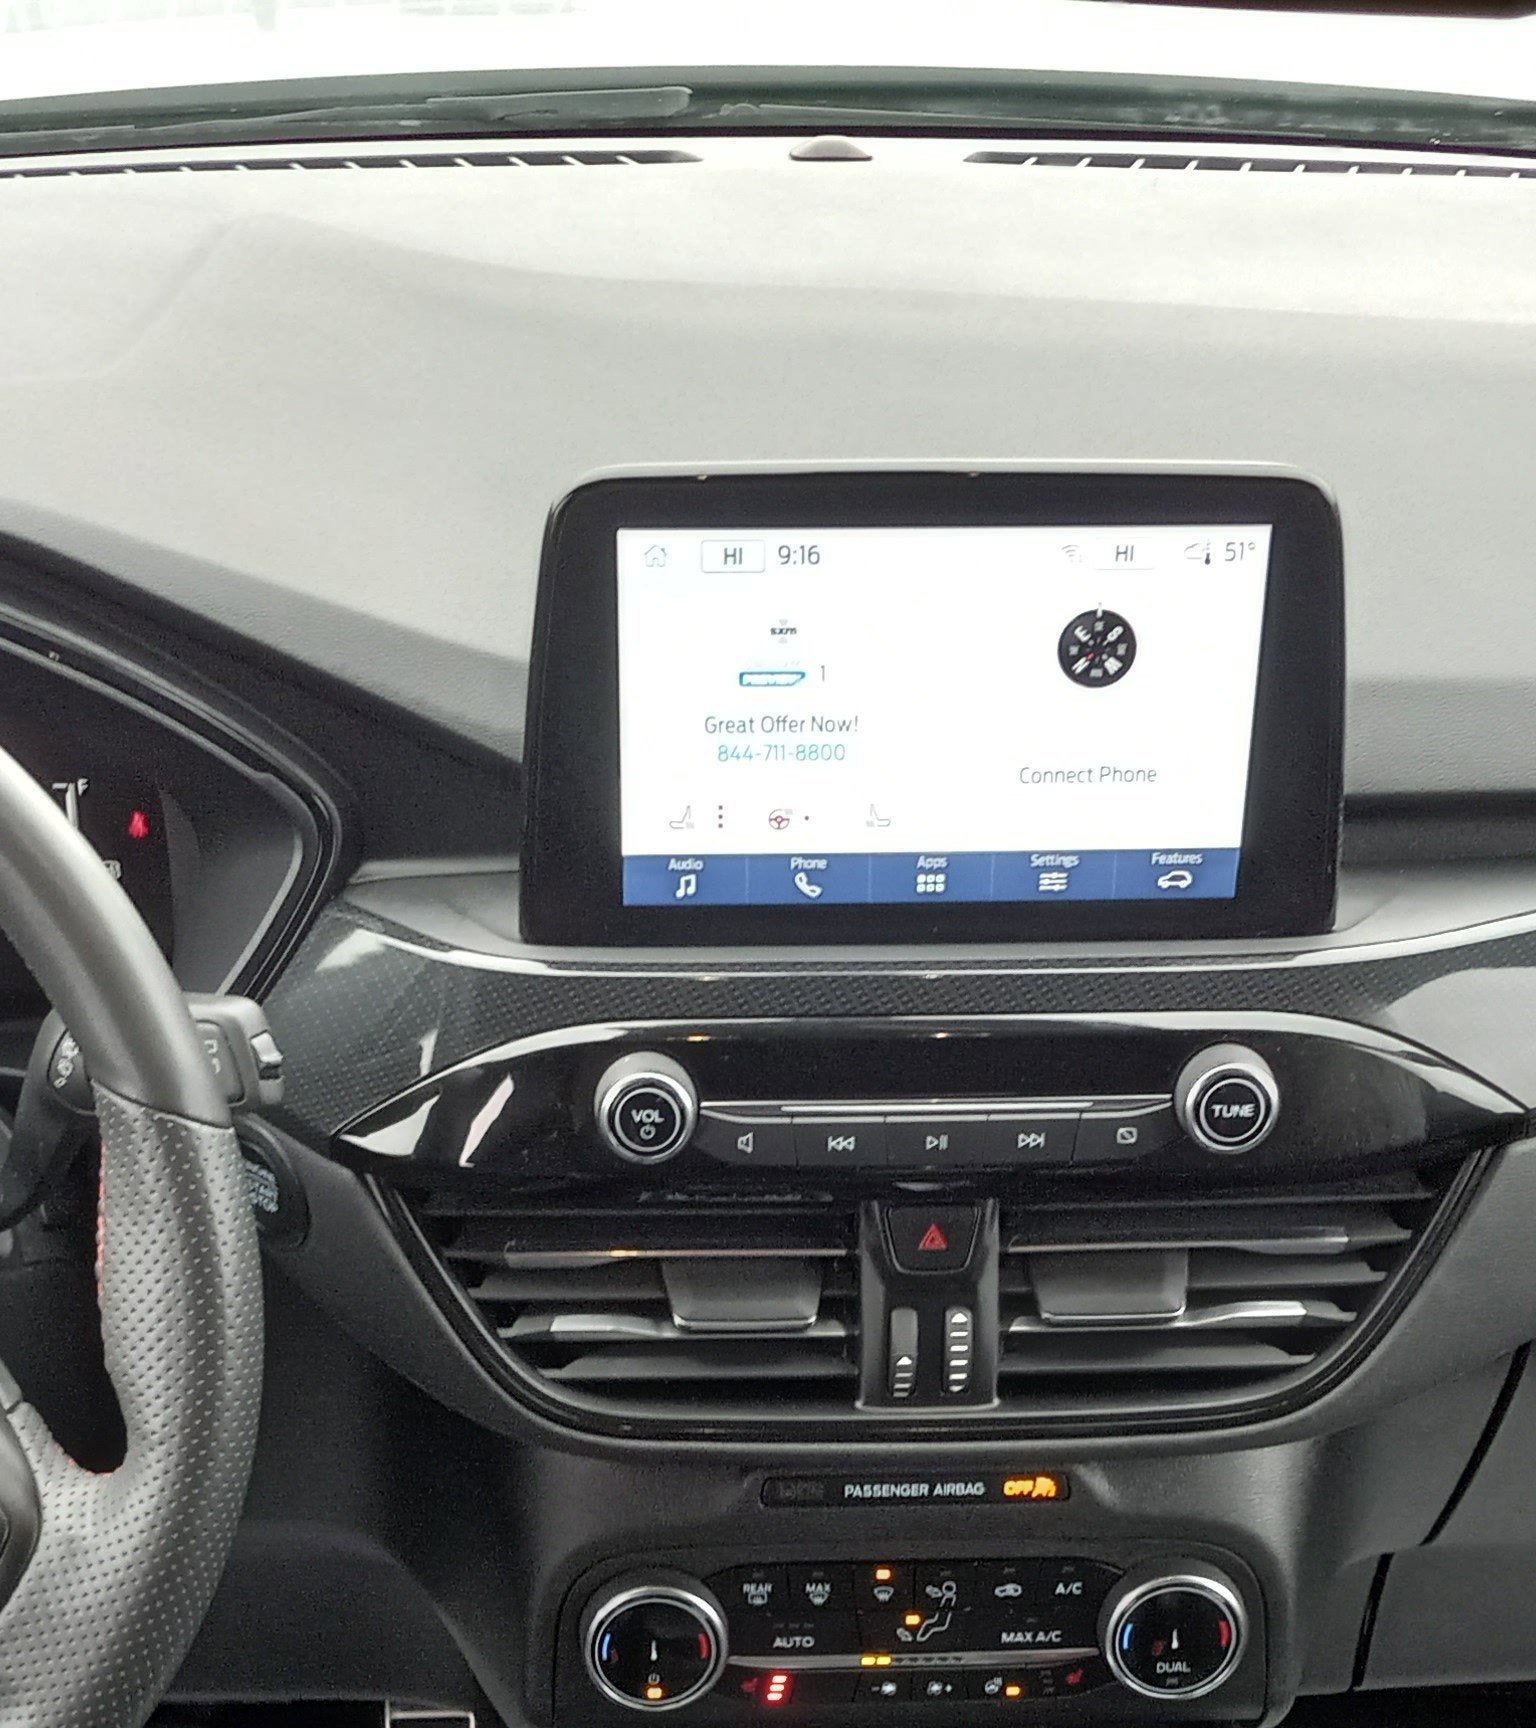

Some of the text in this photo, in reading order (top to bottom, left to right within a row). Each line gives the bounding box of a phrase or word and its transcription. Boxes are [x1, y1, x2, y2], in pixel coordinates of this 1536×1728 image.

[722, 547, 744, 566] HI
[777, 545, 821, 566] 9:16
[1114, 545, 1135, 562] HI
[1224, 542, 1256, 562] 51°
[704, 715, 859, 734] Great Offer Now!
[717, 744, 846, 762] 844-711-8800
[1019, 766, 1157, 784] Connect Phone
[668, 857, 704, 872] Audio
[790, 855, 828, 871] Phone
[917, 854, 948, 870] Apps
[1030, 852, 1080, 870] Settings
[1150, 851, 1203, 866] Features
[630, 1108, 665, 1123] VOL
[1210, 1103, 1255, 1119] TUNE
[844, 1483, 930, 1498] PASSENGER
[932, 1481, 985, 1497] AIRBAG
[1003, 1479, 1033, 1497] OFF
[742, 1582, 773, 1594] REAR
[805, 1582, 832, 1594] MAX
[1054, 1581, 1084, 1596] A/C
[773, 1636, 815, 1649] AUTO
[1000, 1629, 1063, 1644] MAX A/C
[1155, 1660, 1192, 1674] DUAL
